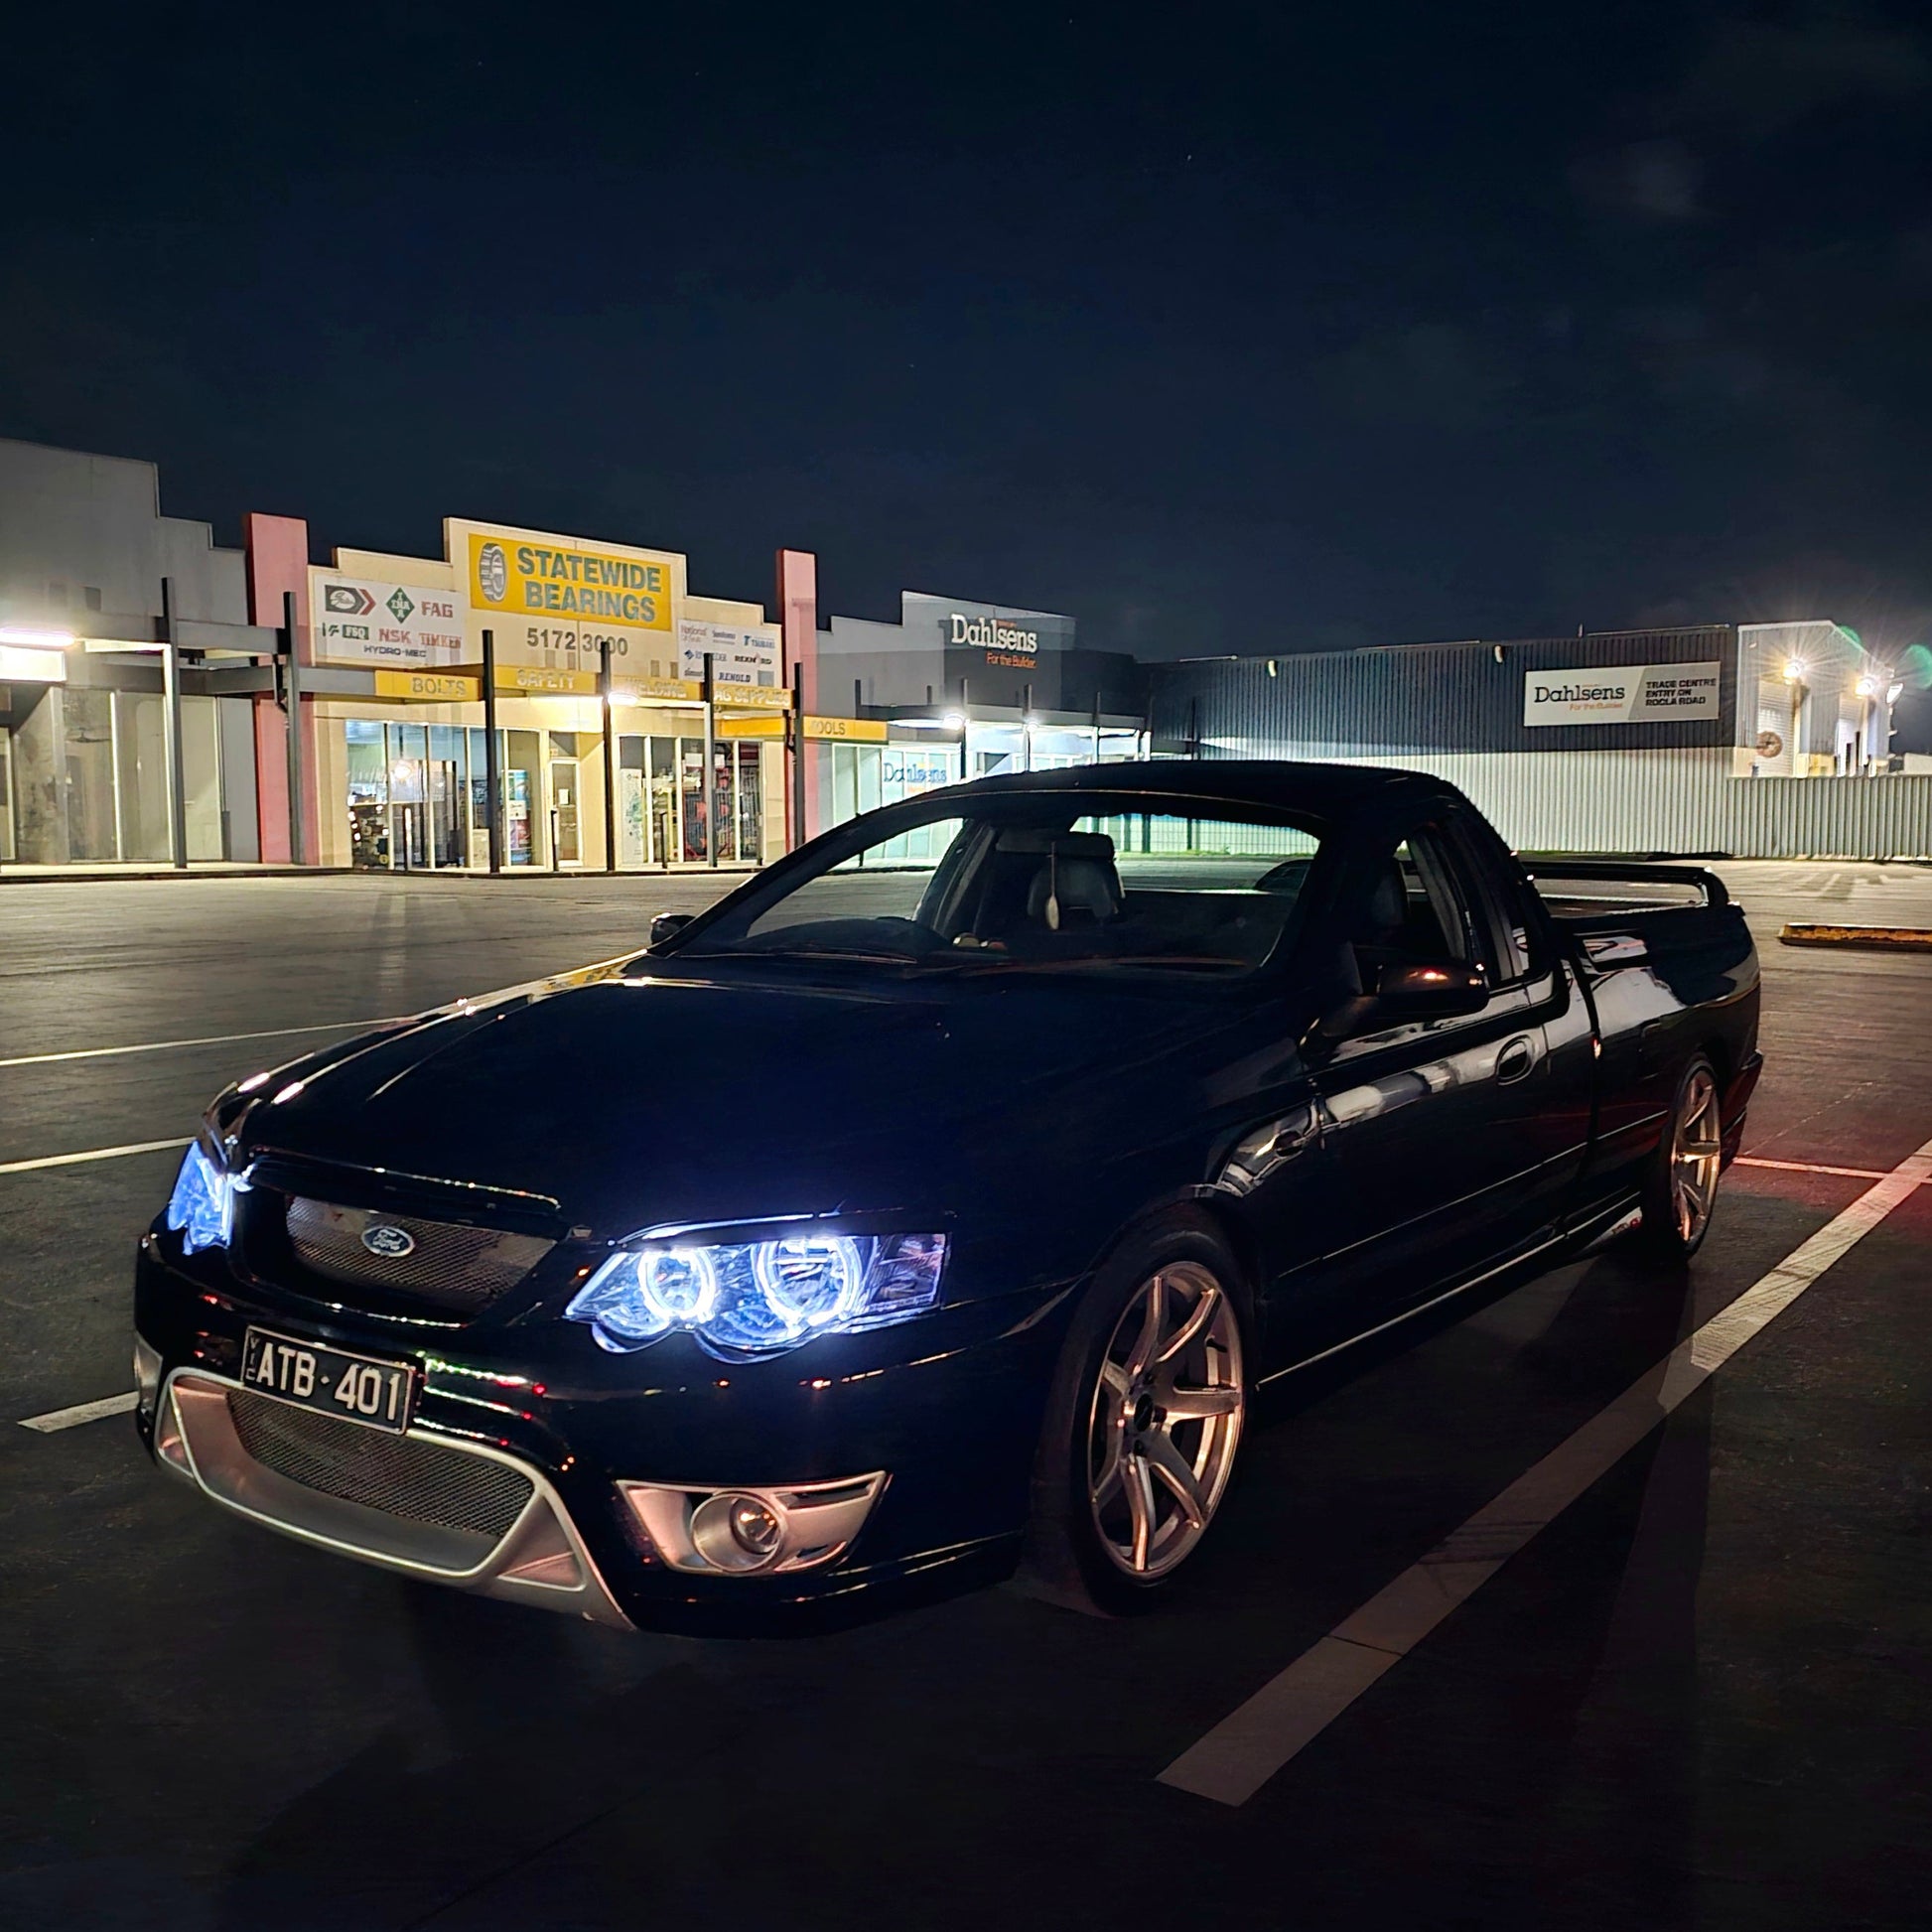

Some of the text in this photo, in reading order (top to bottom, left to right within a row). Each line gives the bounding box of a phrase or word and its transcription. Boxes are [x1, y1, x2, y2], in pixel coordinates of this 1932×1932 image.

[517, 547, 662, 593] STATEWIDE
[421, 601, 454, 618] FAG
[525, 580, 656, 622] BEARINGS
[378, 628, 412, 644] NSK
[419, 632, 463, 649] TIMKEN
[527, 627, 628, 656] 5172 3000
[951, 614, 1038, 653] Dahlsens
[412, 677, 467, 695] BOLTS
[516, 668, 575, 689] SAFETY
[719, 672, 752, 683] RENOLD
[1645, 678, 1717, 689] TRADE CENTRE
[713, 685, 732, 702] AG
[1534, 685, 1626, 704] Dahlsens
[1678, 696, 1707, 706] ROAD
[256, 1341, 402, 1422] ATB 401
